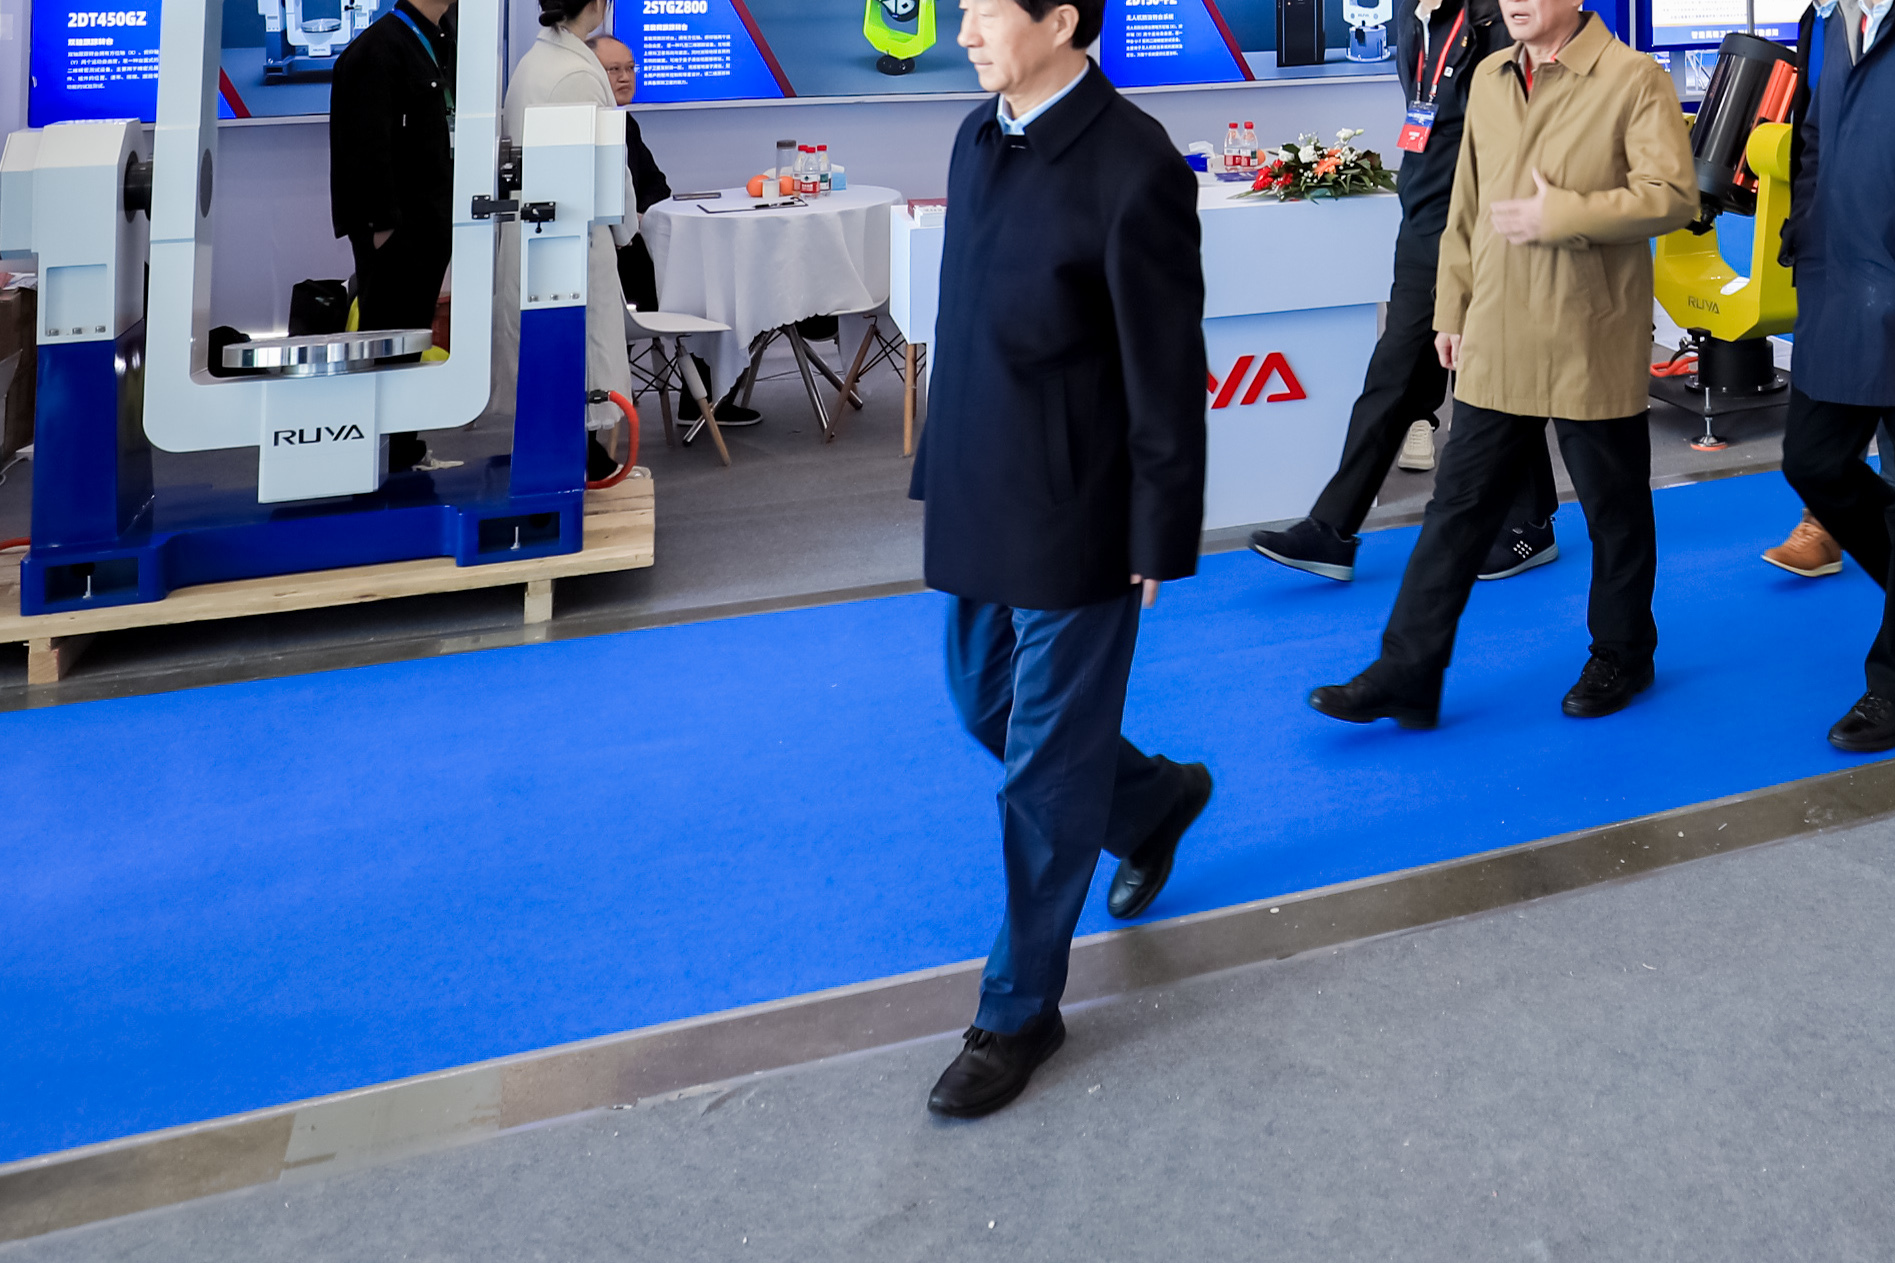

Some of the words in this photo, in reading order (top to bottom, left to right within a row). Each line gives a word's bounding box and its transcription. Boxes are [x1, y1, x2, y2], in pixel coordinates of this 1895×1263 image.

[642, 0, 708, 15] 2STGZ800
[67, 11, 147, 28] 2DT450GZ
[1687, 295, 1720, 315] RUYA
[1206, 352, 1307, 410] YA
[273, 424, 365, 447] RUYA
